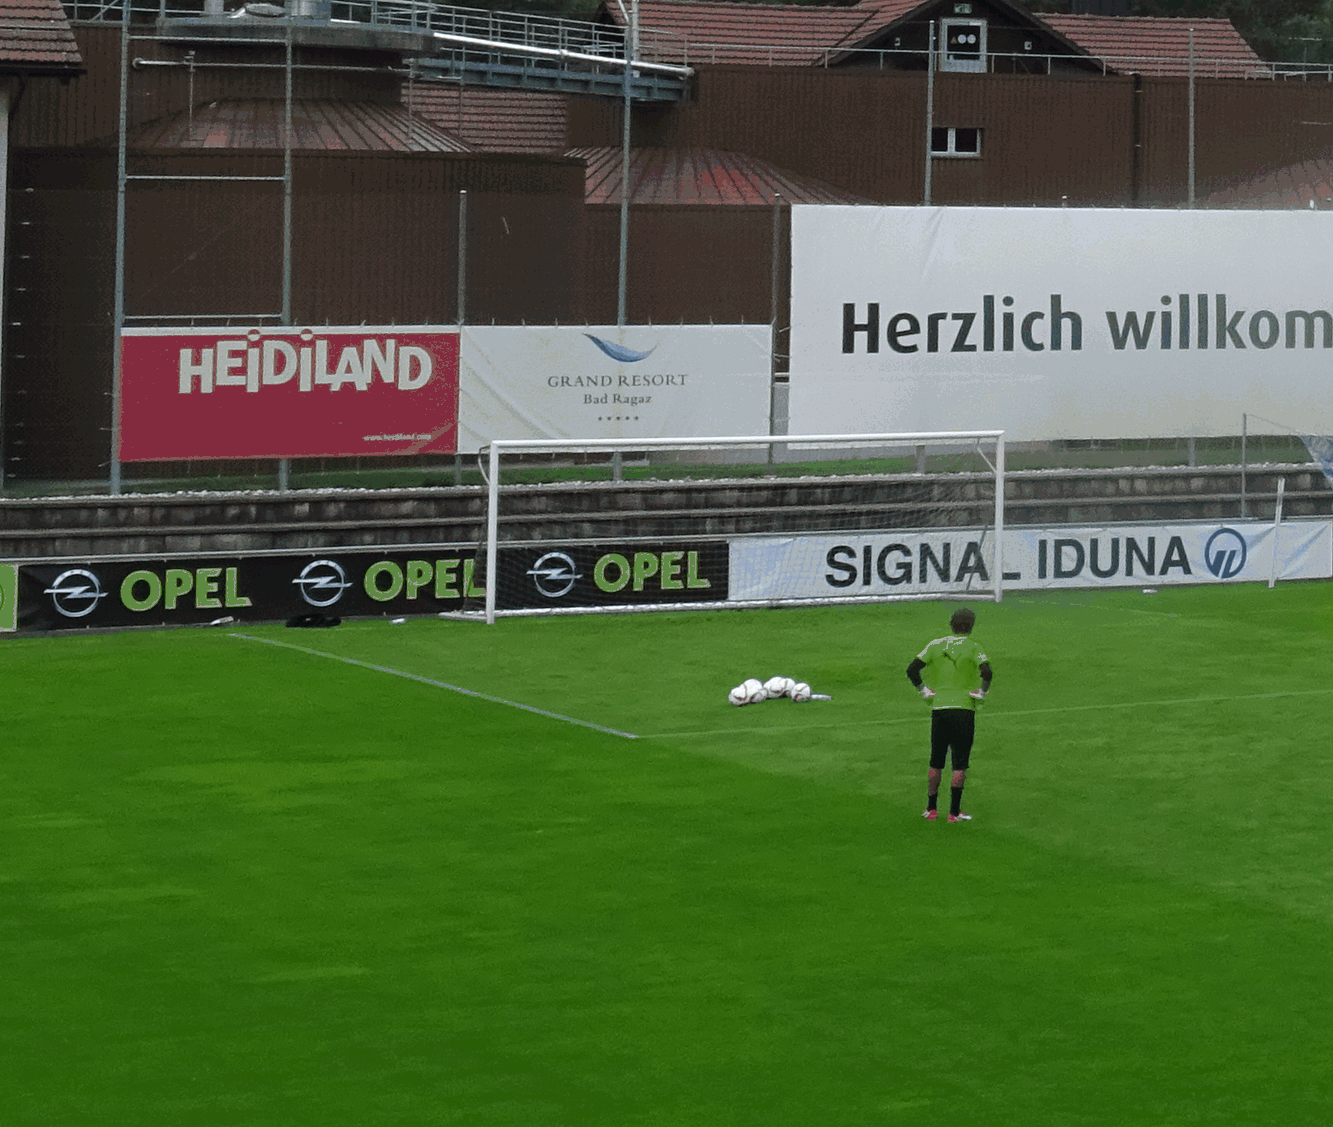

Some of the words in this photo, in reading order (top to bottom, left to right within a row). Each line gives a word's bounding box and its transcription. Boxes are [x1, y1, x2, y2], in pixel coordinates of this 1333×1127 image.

[841, 294, 1083, 354] Herzlich
[547, 375, 613, 388] GRAND
[617, 374, 689, 387] RESORT
[583, 393, 608, 405] Bad
[612, 393, 653, 407] Ragaz
[363, 558, 487, 602] OPEL
[593, 550, 712, 593] OPEL
[825, 541, 1021, 588] SIGNA
[1037, 535, 1193, 580] IDUNA
[119, 567, 253, 612] OPEL
